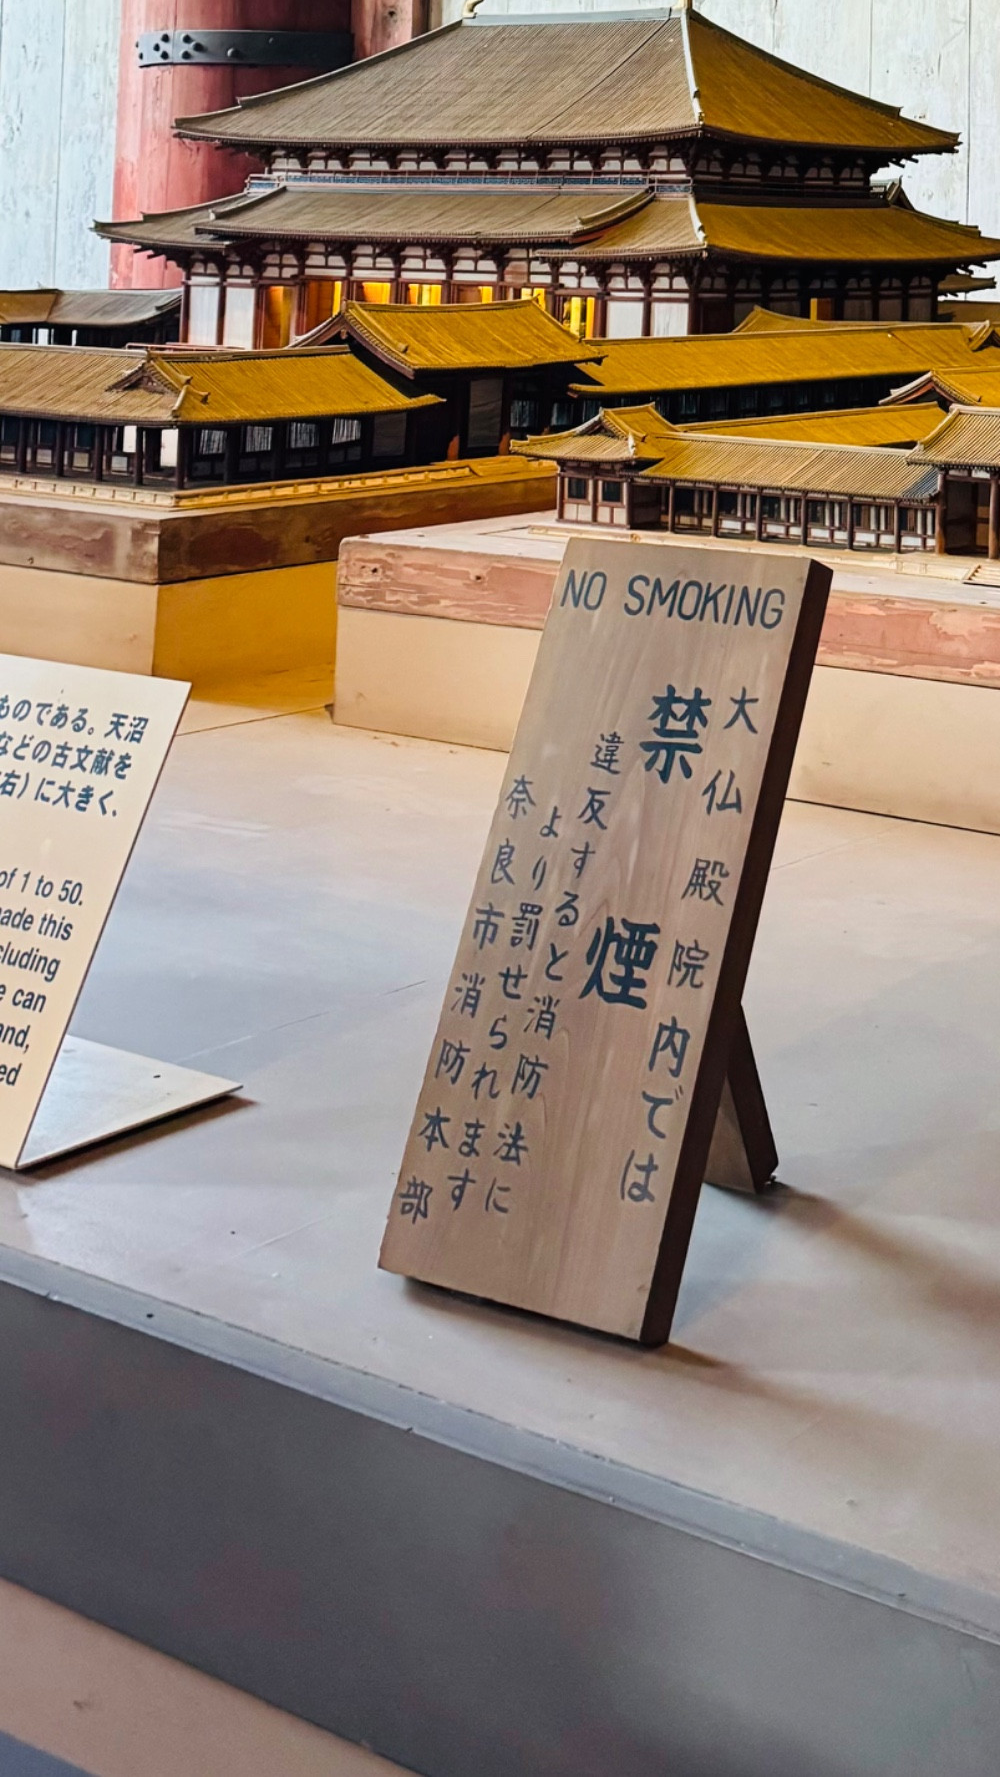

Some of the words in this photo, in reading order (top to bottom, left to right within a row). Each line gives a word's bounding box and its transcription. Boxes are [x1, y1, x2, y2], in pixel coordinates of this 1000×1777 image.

[560, 569, 607, 611] NO
[624, 574, 785, 630] SMOKING
[0, 868, 18, 889] of
[21, 871, 31, 893] 1
[35, 875, 54, 898] to
[58, 879, 83, 906] 50.
[0, 907, 34, 931] ade
[38, 913, 73, 941] this
[12, 988, 47, 1013] can
[399, 774, 537, 1224] 奈良市消防本部
[447, 805, 563, 1212] より罰せられます
[485, 731, 625, 1214] 違反すると消防法に
[578, 684, 713, 1010] 禁煙
[620, 686, 760, 1203] 大仏殿院内では
